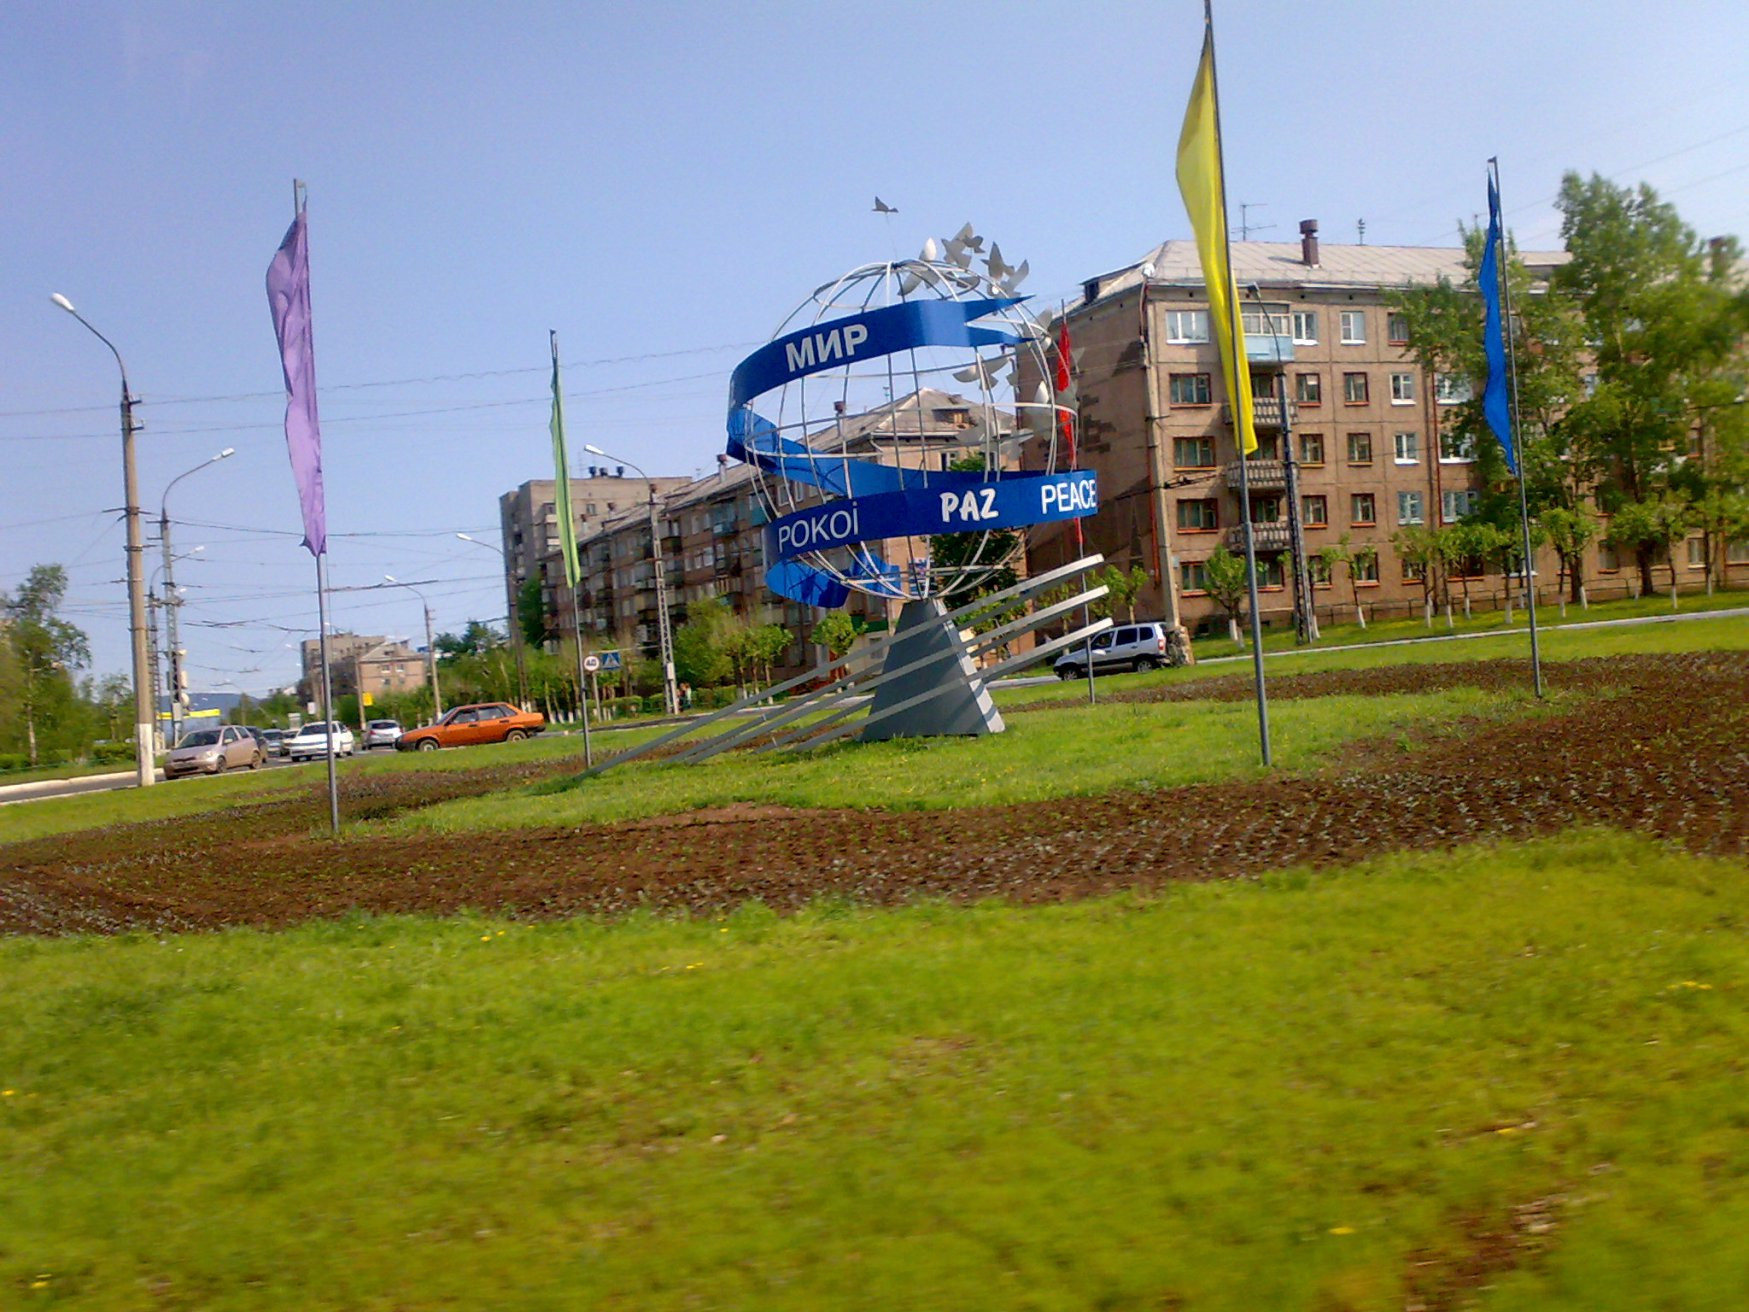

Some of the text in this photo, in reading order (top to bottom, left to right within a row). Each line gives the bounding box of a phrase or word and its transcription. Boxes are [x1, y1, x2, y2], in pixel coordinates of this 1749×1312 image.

[785, 324, 868, 372] МИР
[939, 488, 999, 522] PAZ
[1041, 480, 1097, 514] PEACE
